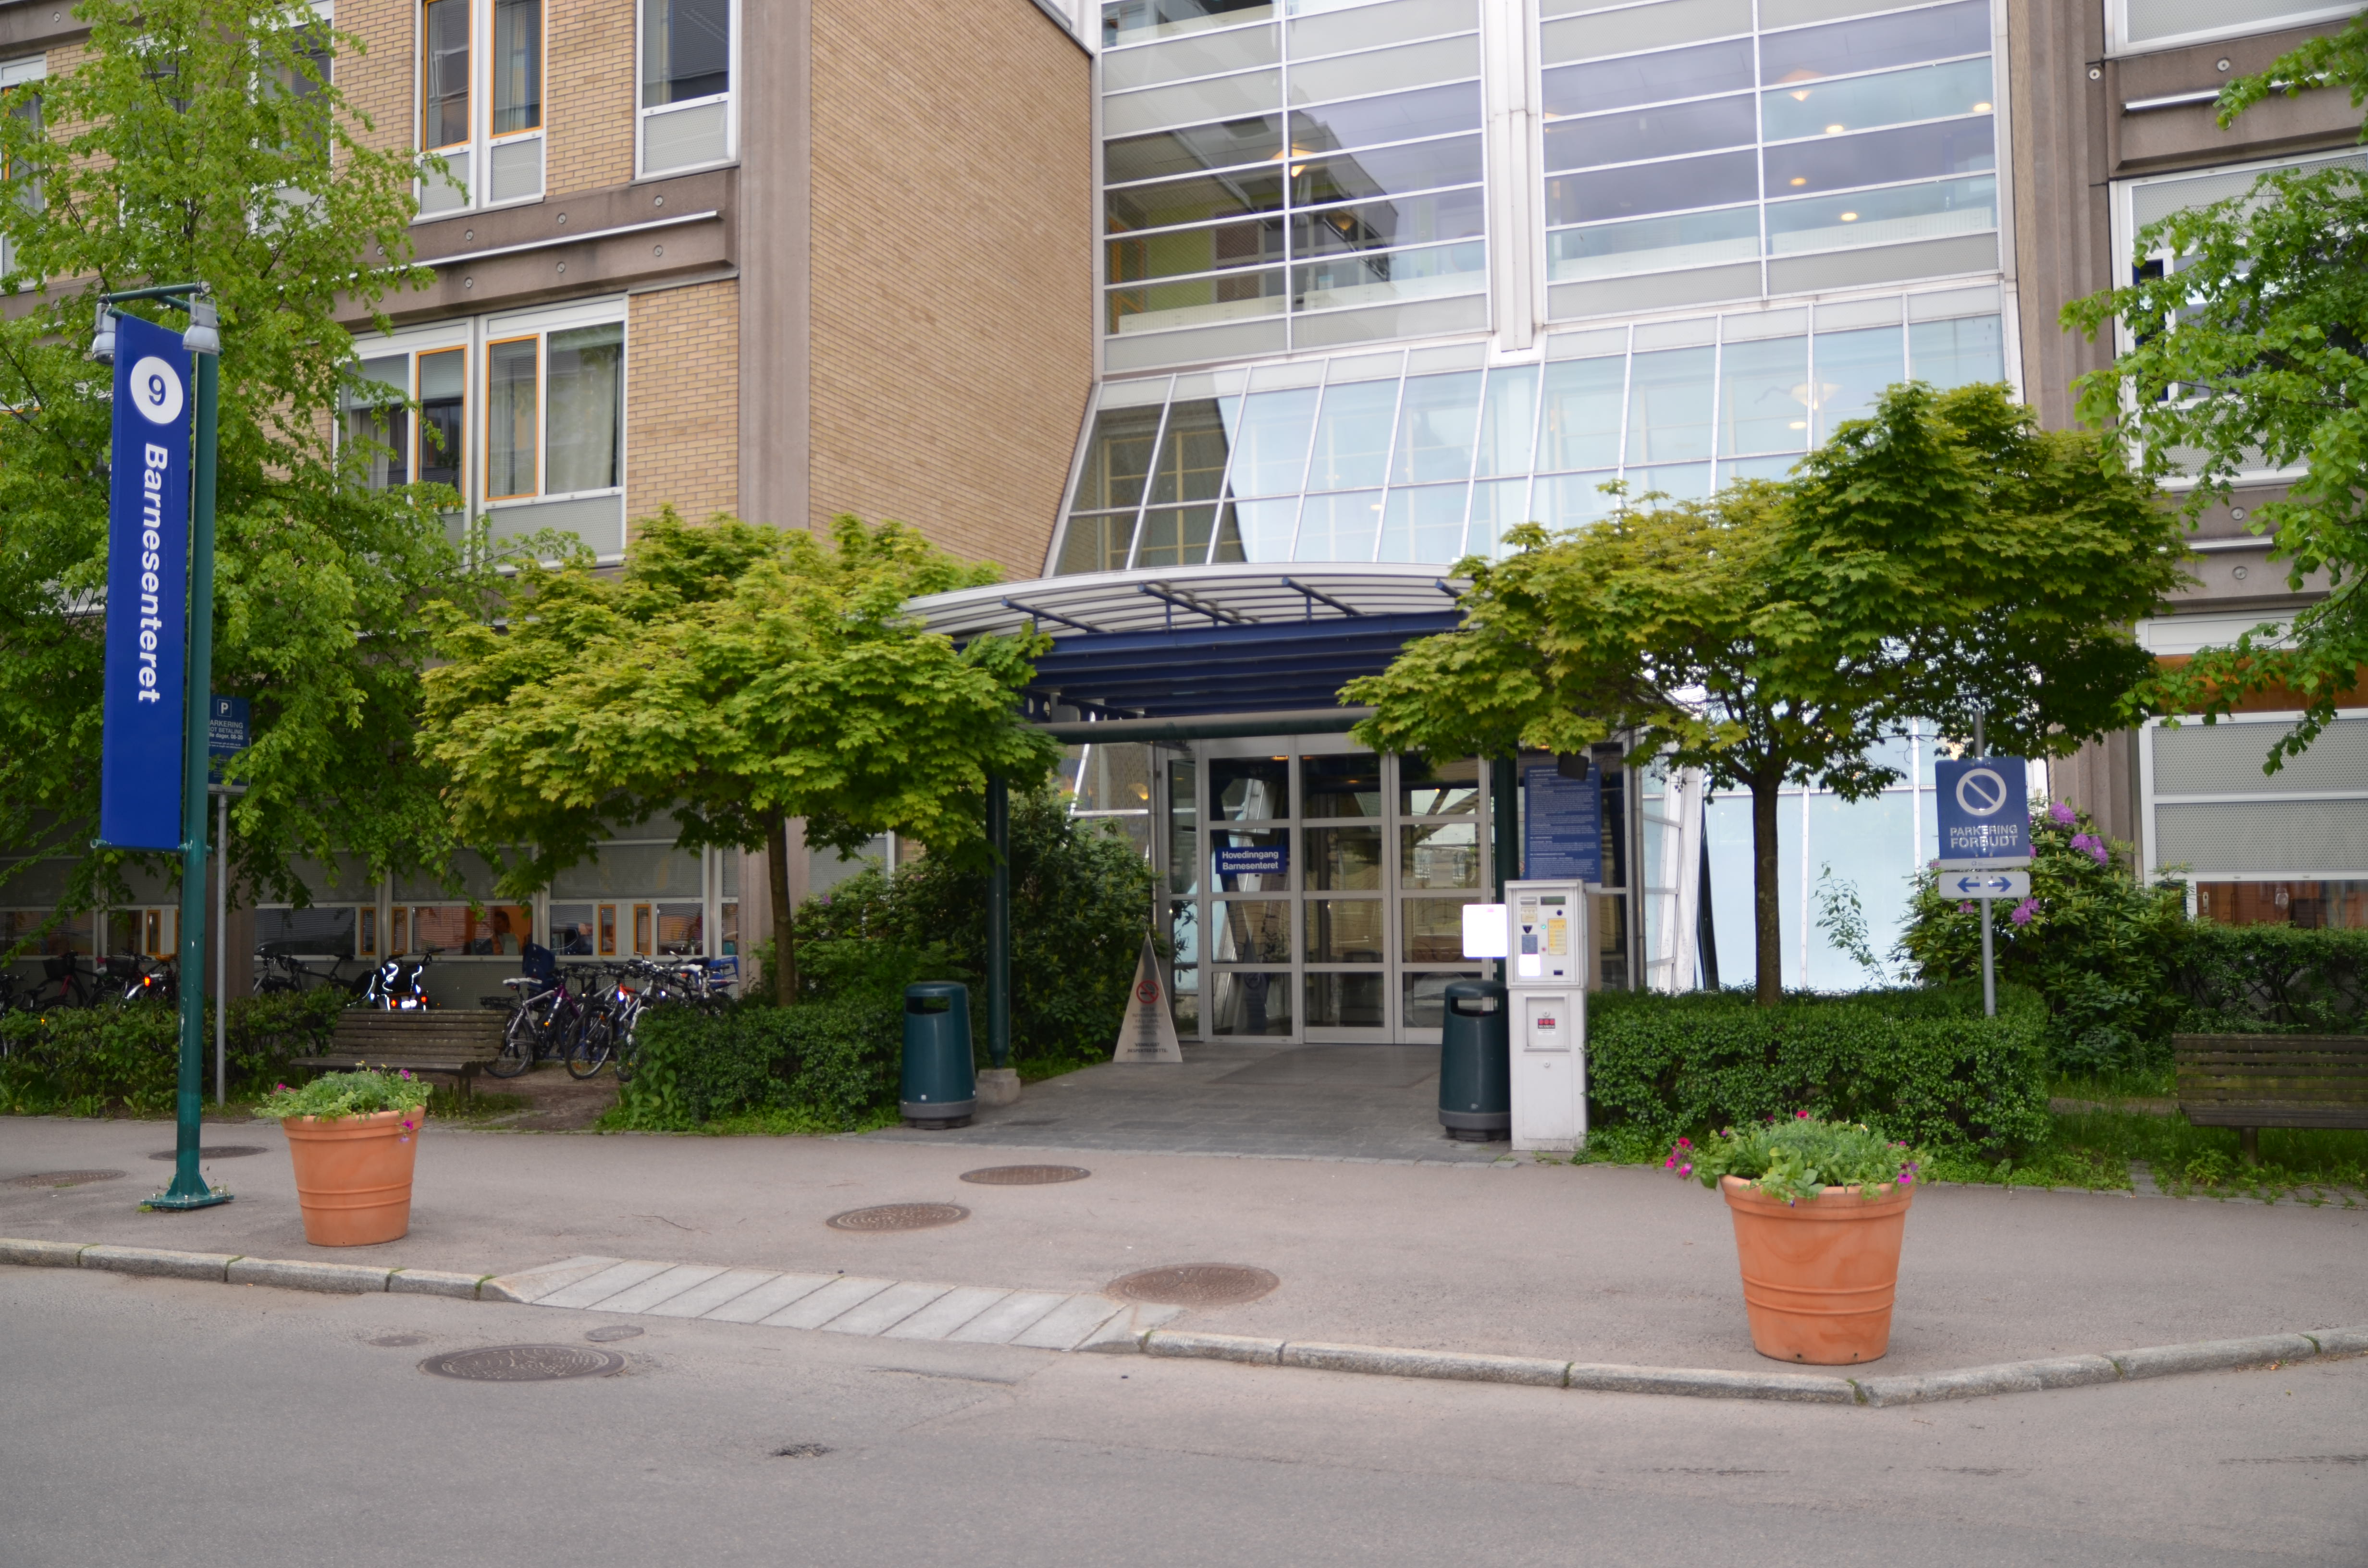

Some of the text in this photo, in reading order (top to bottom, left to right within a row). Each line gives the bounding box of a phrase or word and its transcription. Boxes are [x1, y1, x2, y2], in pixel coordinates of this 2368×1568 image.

[148, 373, 166, 407] 9
[138, 443, 168, 703] Barnesenteret
[221, 702, 229, 714] P
[210, 720, 243, 728] ARKERING
[1950, 825, 2018, 836] PARKERING
[1950, 835, 2018, 848] FORBUDT
[1222, 851, 1279, 859] Hovedinngang
[1222, 861, 1279, 870] Barnesenteret
